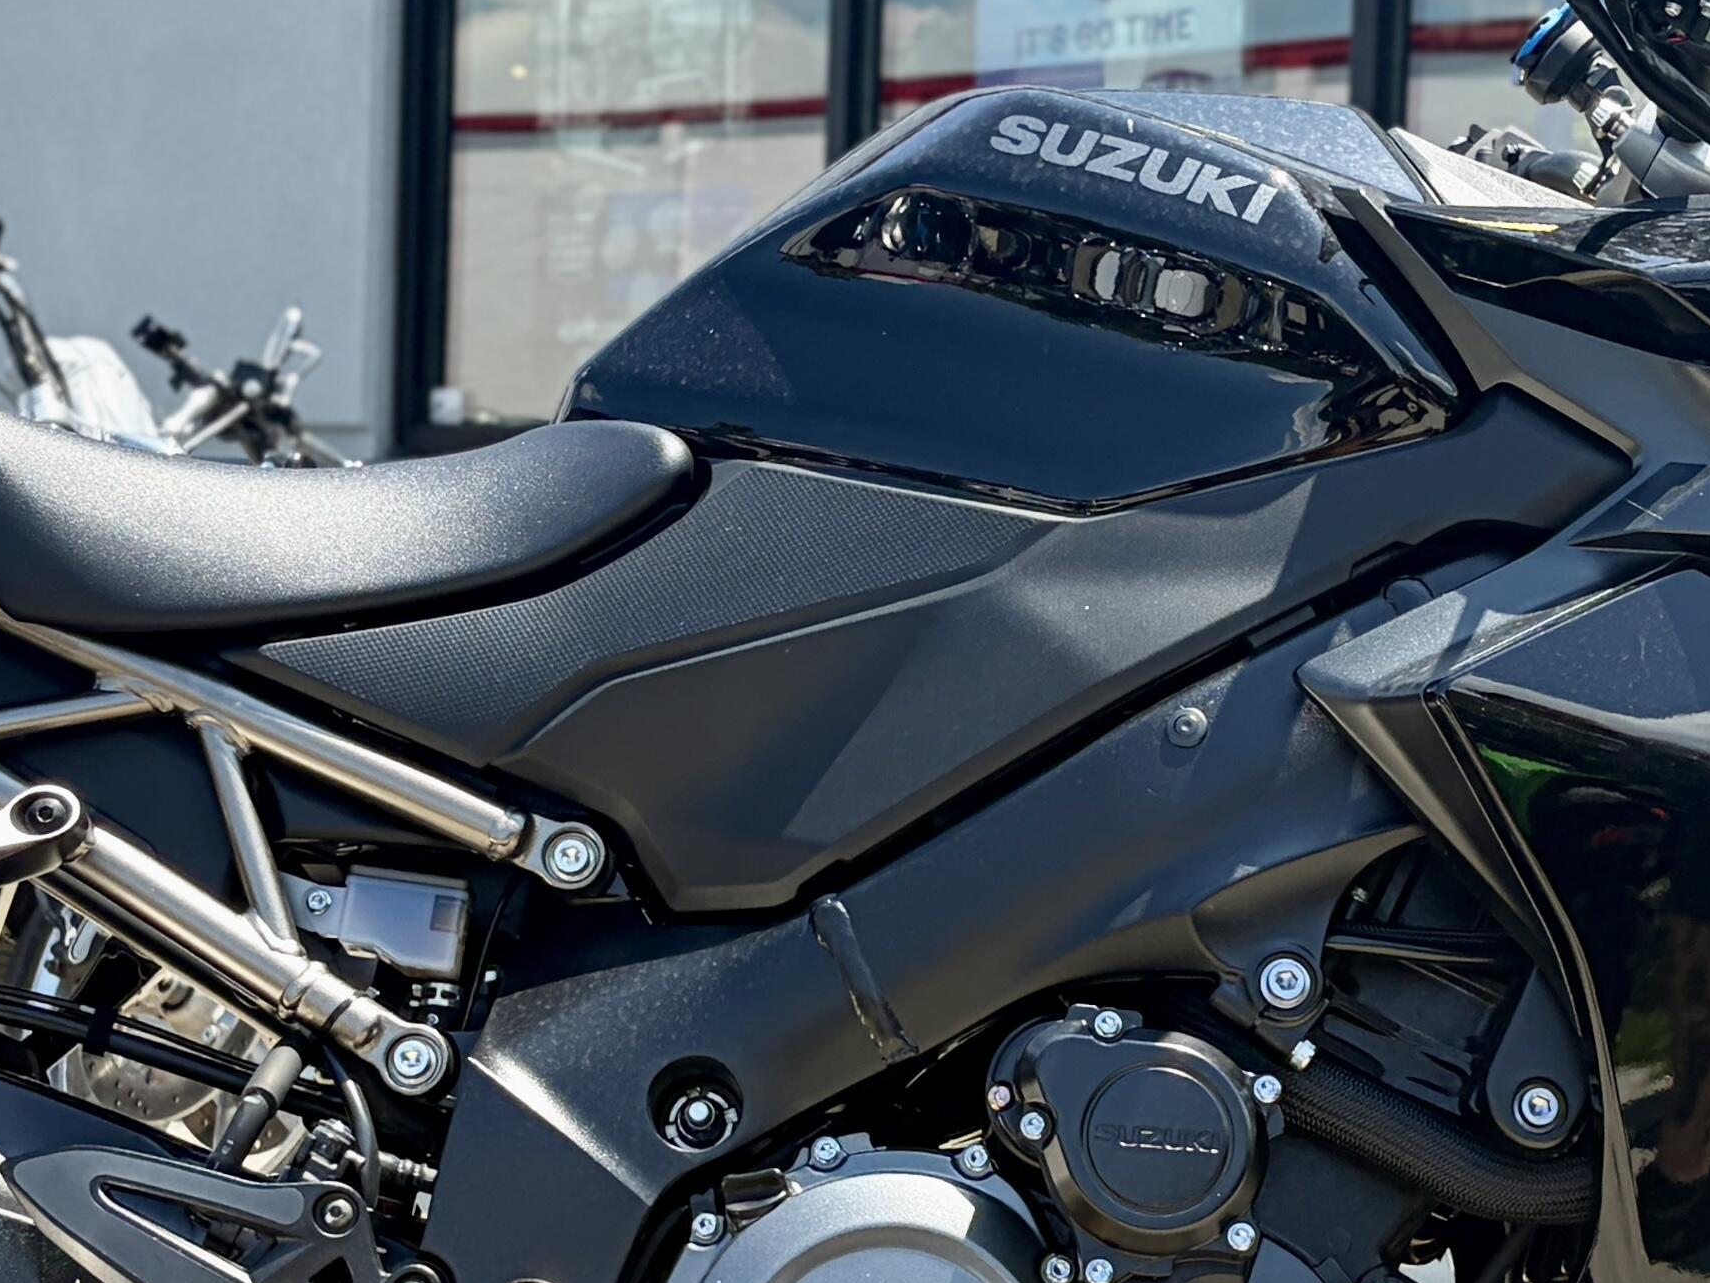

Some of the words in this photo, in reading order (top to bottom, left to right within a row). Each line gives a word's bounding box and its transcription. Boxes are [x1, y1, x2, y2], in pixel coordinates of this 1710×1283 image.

[1125, 9, 1194, 45] TIME
[990, 114, 1279, 225] SUZUKI
[1093, 1121, 1221, 1155] SUZUKI
